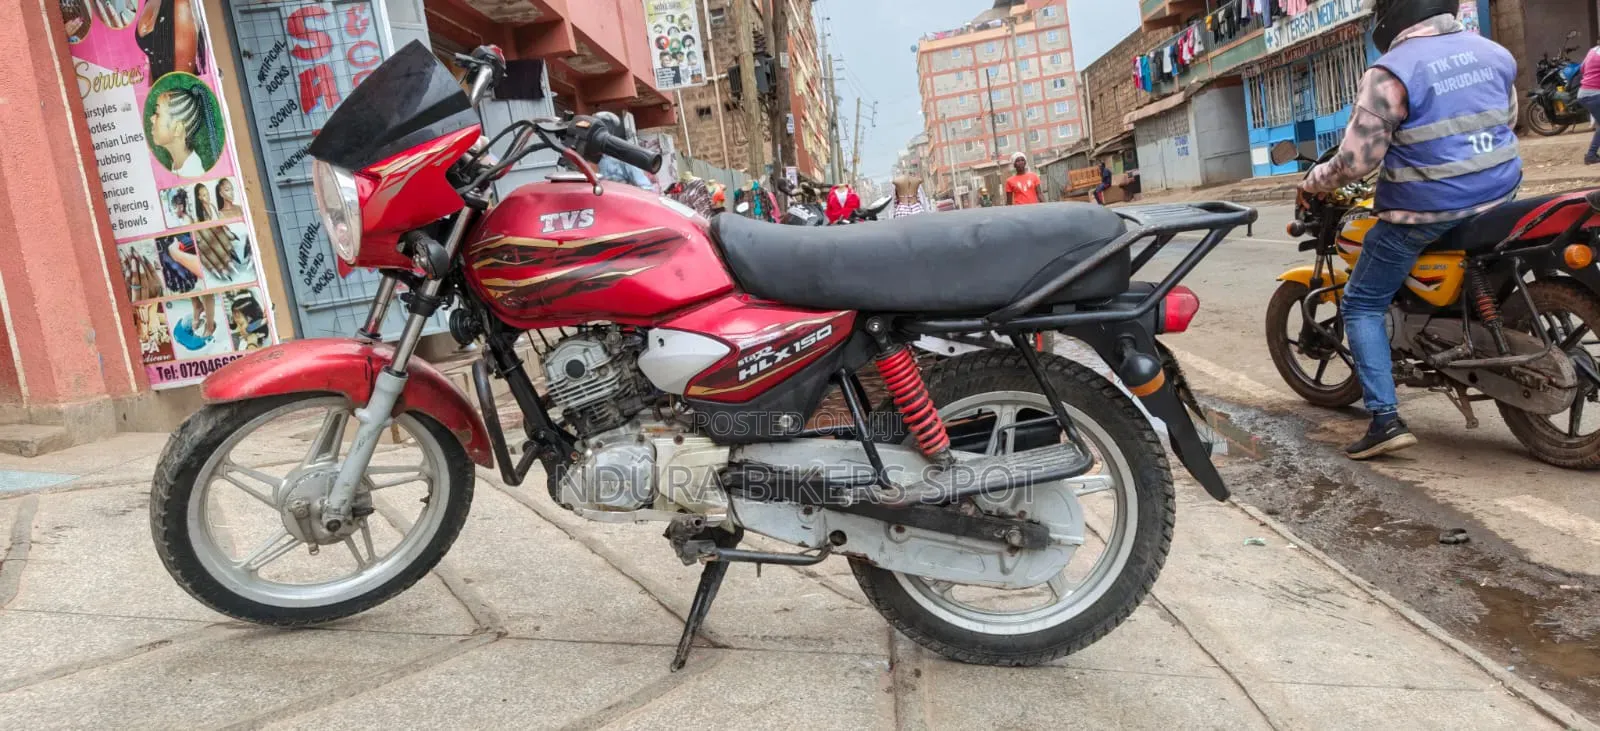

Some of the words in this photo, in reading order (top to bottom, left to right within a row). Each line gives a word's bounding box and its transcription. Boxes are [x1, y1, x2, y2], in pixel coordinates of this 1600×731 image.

[1285, 11, 1316, 41] TERESA
[1316, 0, 1349, 28] MEDICAL
[1284, 37, 1321, 61] MEDICAL
[258, 40, 287, 84] ARTIFICIAL
[1428, 57, 1452, 74] TIK
[1450, 51, 1478, 66] TOK
[75, 61, 145, 99] Services
[266, 65, 290, 95] ROCKS
[1433, 66, 1494, 96] BURUDANI
[270, 98, 298, 128] SCRUB
[88, 122, 116, 135] otless
[92, 137, 119, 151] anian
[120, 132, 144, 145] Lines
[1468, 132, 1493, 153] 10
[96, 152, 132, 166] rubbing
[99, 170, 128, 183] dicure
[103, 186, 135, 199] anicure
[113, 200, 149, 214] Piercing
[118, 215, 148, 230] Browls
[540, 208, 594, 233] TVS
[298, 222, 320, 270] NATURAL
[303, 252, 325, 287] DREAD
[312, 268, 336, 294] ROCKS
[739, 347, 792, 381] HLX
[793, 324, 832, 352] 150
[156, 365, 179, 380] Tel:
